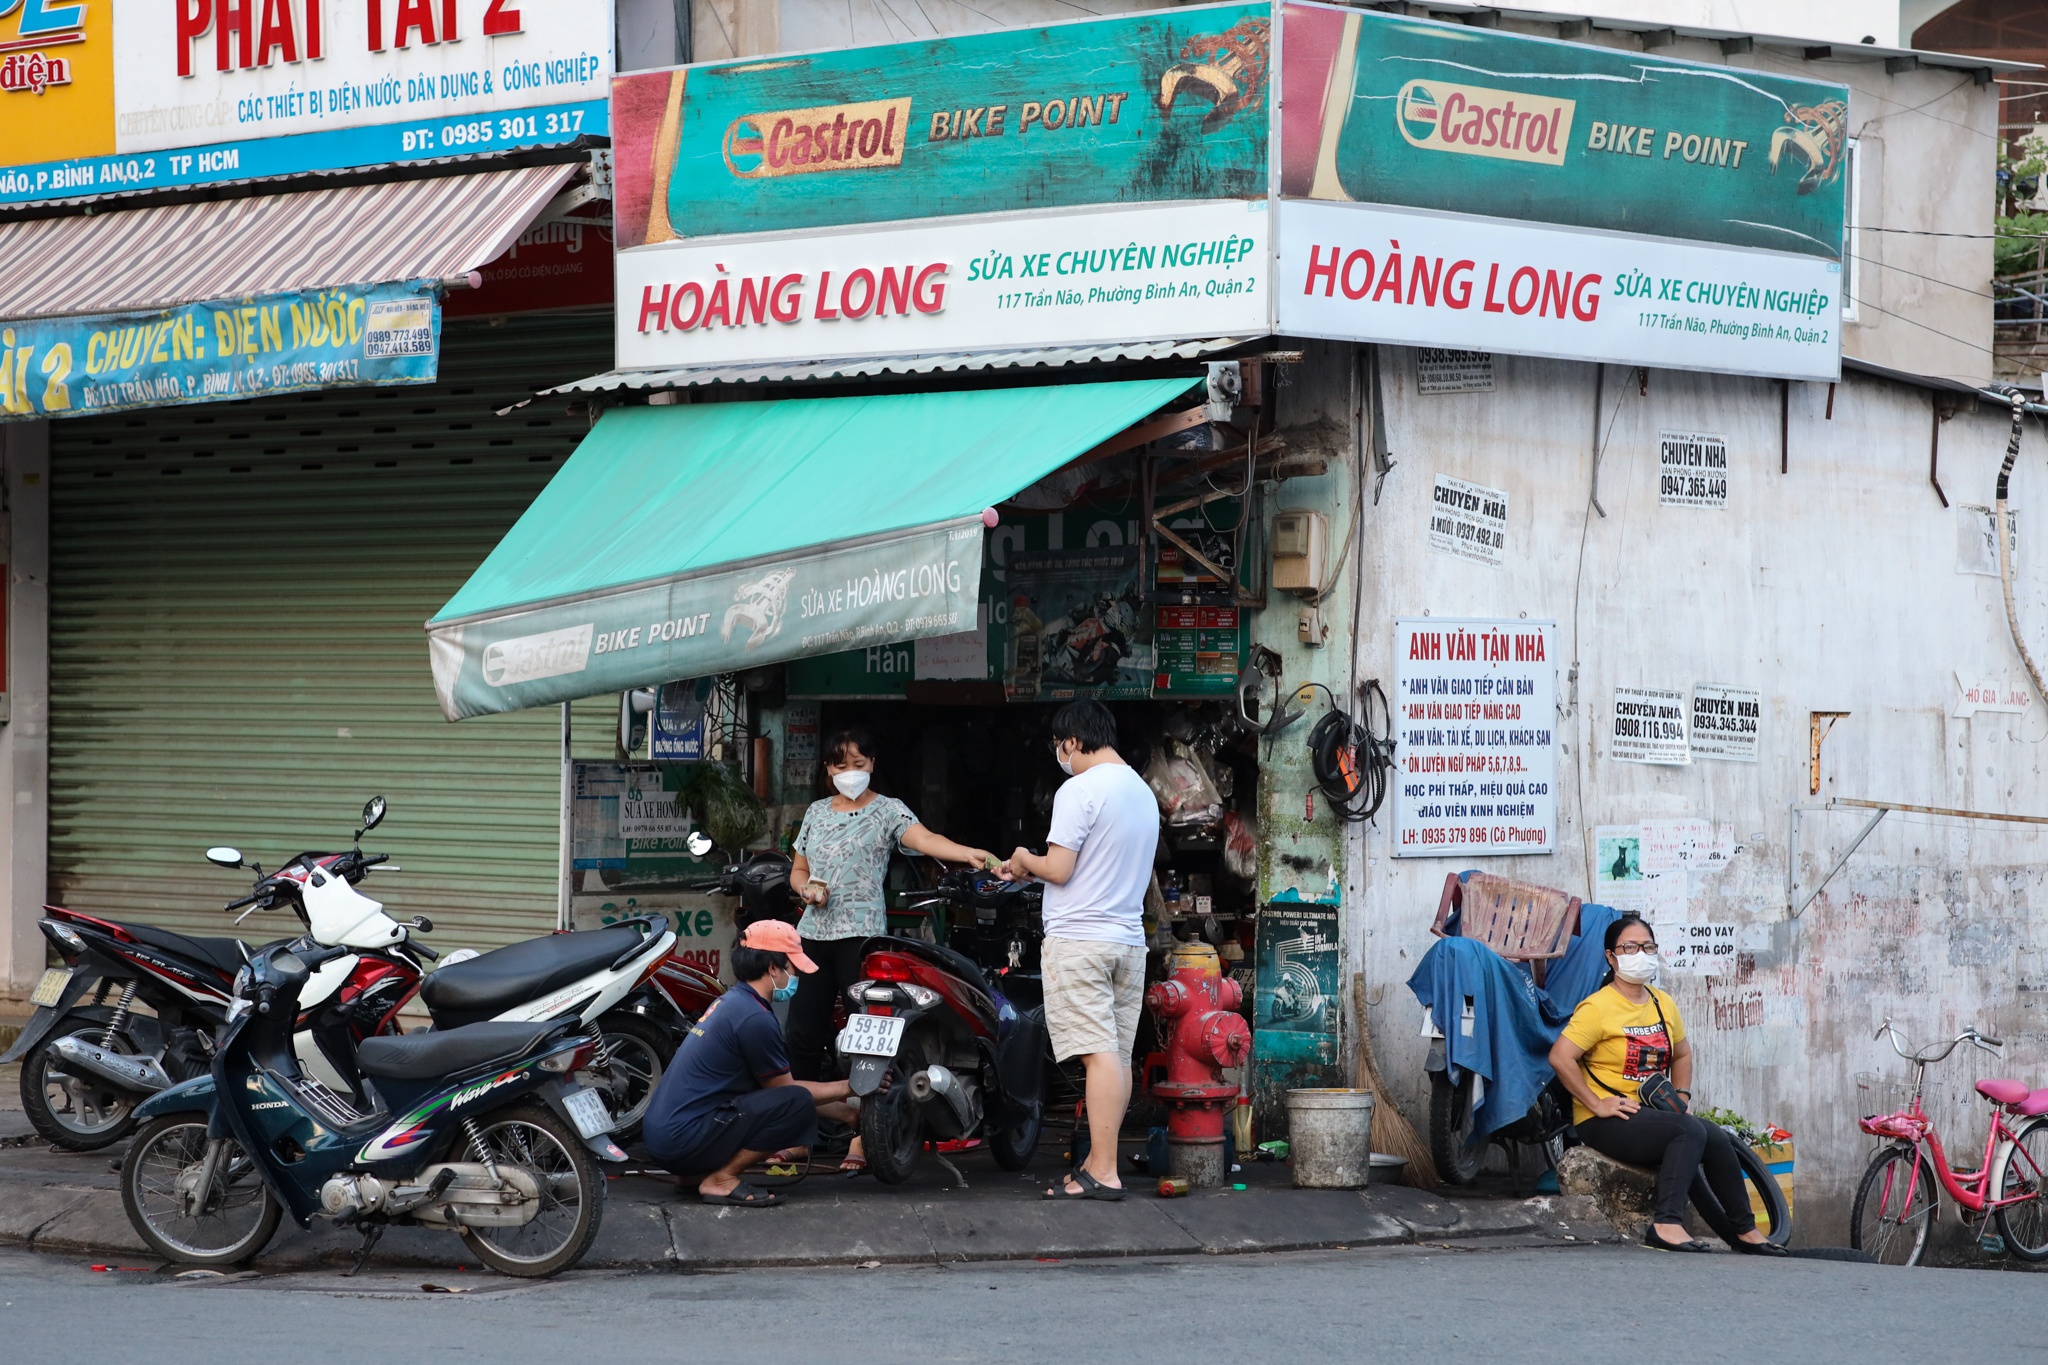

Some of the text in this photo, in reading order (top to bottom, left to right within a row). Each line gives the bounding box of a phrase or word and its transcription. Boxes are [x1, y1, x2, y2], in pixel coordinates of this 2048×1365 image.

[1, 53, 66, 93] điện
[238, 51, 599, 123] CÁC THIẾT BỊ ĐIỆN NƯỚC DÂN DỤNG CÔNG NGHIỆP
[402, 110, 585, 151] ĐT: 0985 301 317
[767, 92, 1128, 169] Castrol BIKE POINT
[1441, 93, 1748, 169] Castrol BIKE POINT
[169, 149, 240, 176] TP HCM
[967, 234, 1255, 281] SỬA XE CHUYÊN NGHIỆP
[1304, 239, 1603, 322] HOÀNG LONG
[637, 263, 950, 333] HOÀNG LONG
[997, 277, 1255, 309] 117 Trần Não, Phường Bình An, Quận 2
[1613, 267, 1829, 321] SỬA XE CHUYÊN NGHIỆP
[368, 328, 430, 343] 0989.773.499
[1638, 312, 1828, 347] 117 Trần Não, Phường Bình An, Quận 2
[42, 287, 366, 411] 2 CHUYÊN: ĐIỆN NƯỚC
[368, 340, 431, 355] 0947.413.589
[100, 384, 120, 405] 117
[120, 371, 151, 402] TRẦN
[203, 368, 230, 394] BÌNH
[291, 362, 316, 384] 0985
[1661, 434, 1726, 468] CHUYỂN NHÀ
[1674, 467, 1692, 477] PHÒNG
[1661, 475, 1727, 499] 0947.365.449
[1433, 485, 1506, 520] CHUYỂN NHÀ
[594, 560, 961, 656] BIKE POINT SỬA XE HOÀNG LONG
[1409, 626, 1546, 668] ANH VĂN TẬN NHÀ
[1409, 673, 1534, 696] ANH VĂN GIAO TIẾP CĂN BẢN
[1982, 689, 1997, 704] GIA
[1408, 697, 1521, 720] ANH VĂN GIAO TIẾP NÂNG CAO
[1616, 699, 1683, 719] CHUYỂN NHÀ
[1694, 692, 1760, 718] CHUYỂN NHÀ
[1615, 717, 1684, 740] 0908.116.994
[1693, 714, 1757, 733] 0934.345.344
[1408, 724, 1551, 750] ANH VĂN: TÀI XẾ, DU LỊCH, KHÁCH SẠN
[1408, 752, 1486, 776] ÔN LUYỆN NGỮ PHÁP
[1404, 779, 1548, 799] HỌC PHÍ THẤP, HIỆU QUẢ CAO
[643, 801, 655, 819] XE
[1444, 801, 1535, 819] VIÊN KINH NGHIỆM
[631, 837, 659, 849] Bike
[1402, 826, 1547, 845] LH: 0935 379 896 (Cô Phượng)
[674, 910, 714, 936] xe
[1261, 910, 1326, 920] CASTROL ULTIMATE
[1690, 926, 1735, 937] CHO VAY
[1315, 942, 1338, 953] FORMULA
[1690, 940, 1711, 955] TRẢ
[1713, 941, 1734, 955] GÓP
[855, 1017, 894, 1036] 59-B1
[847, 1034, 894, 1053] 143.84
[251, 1100, 289, 1110] HONDA
[450, 1081, 495, 1112] Wave
